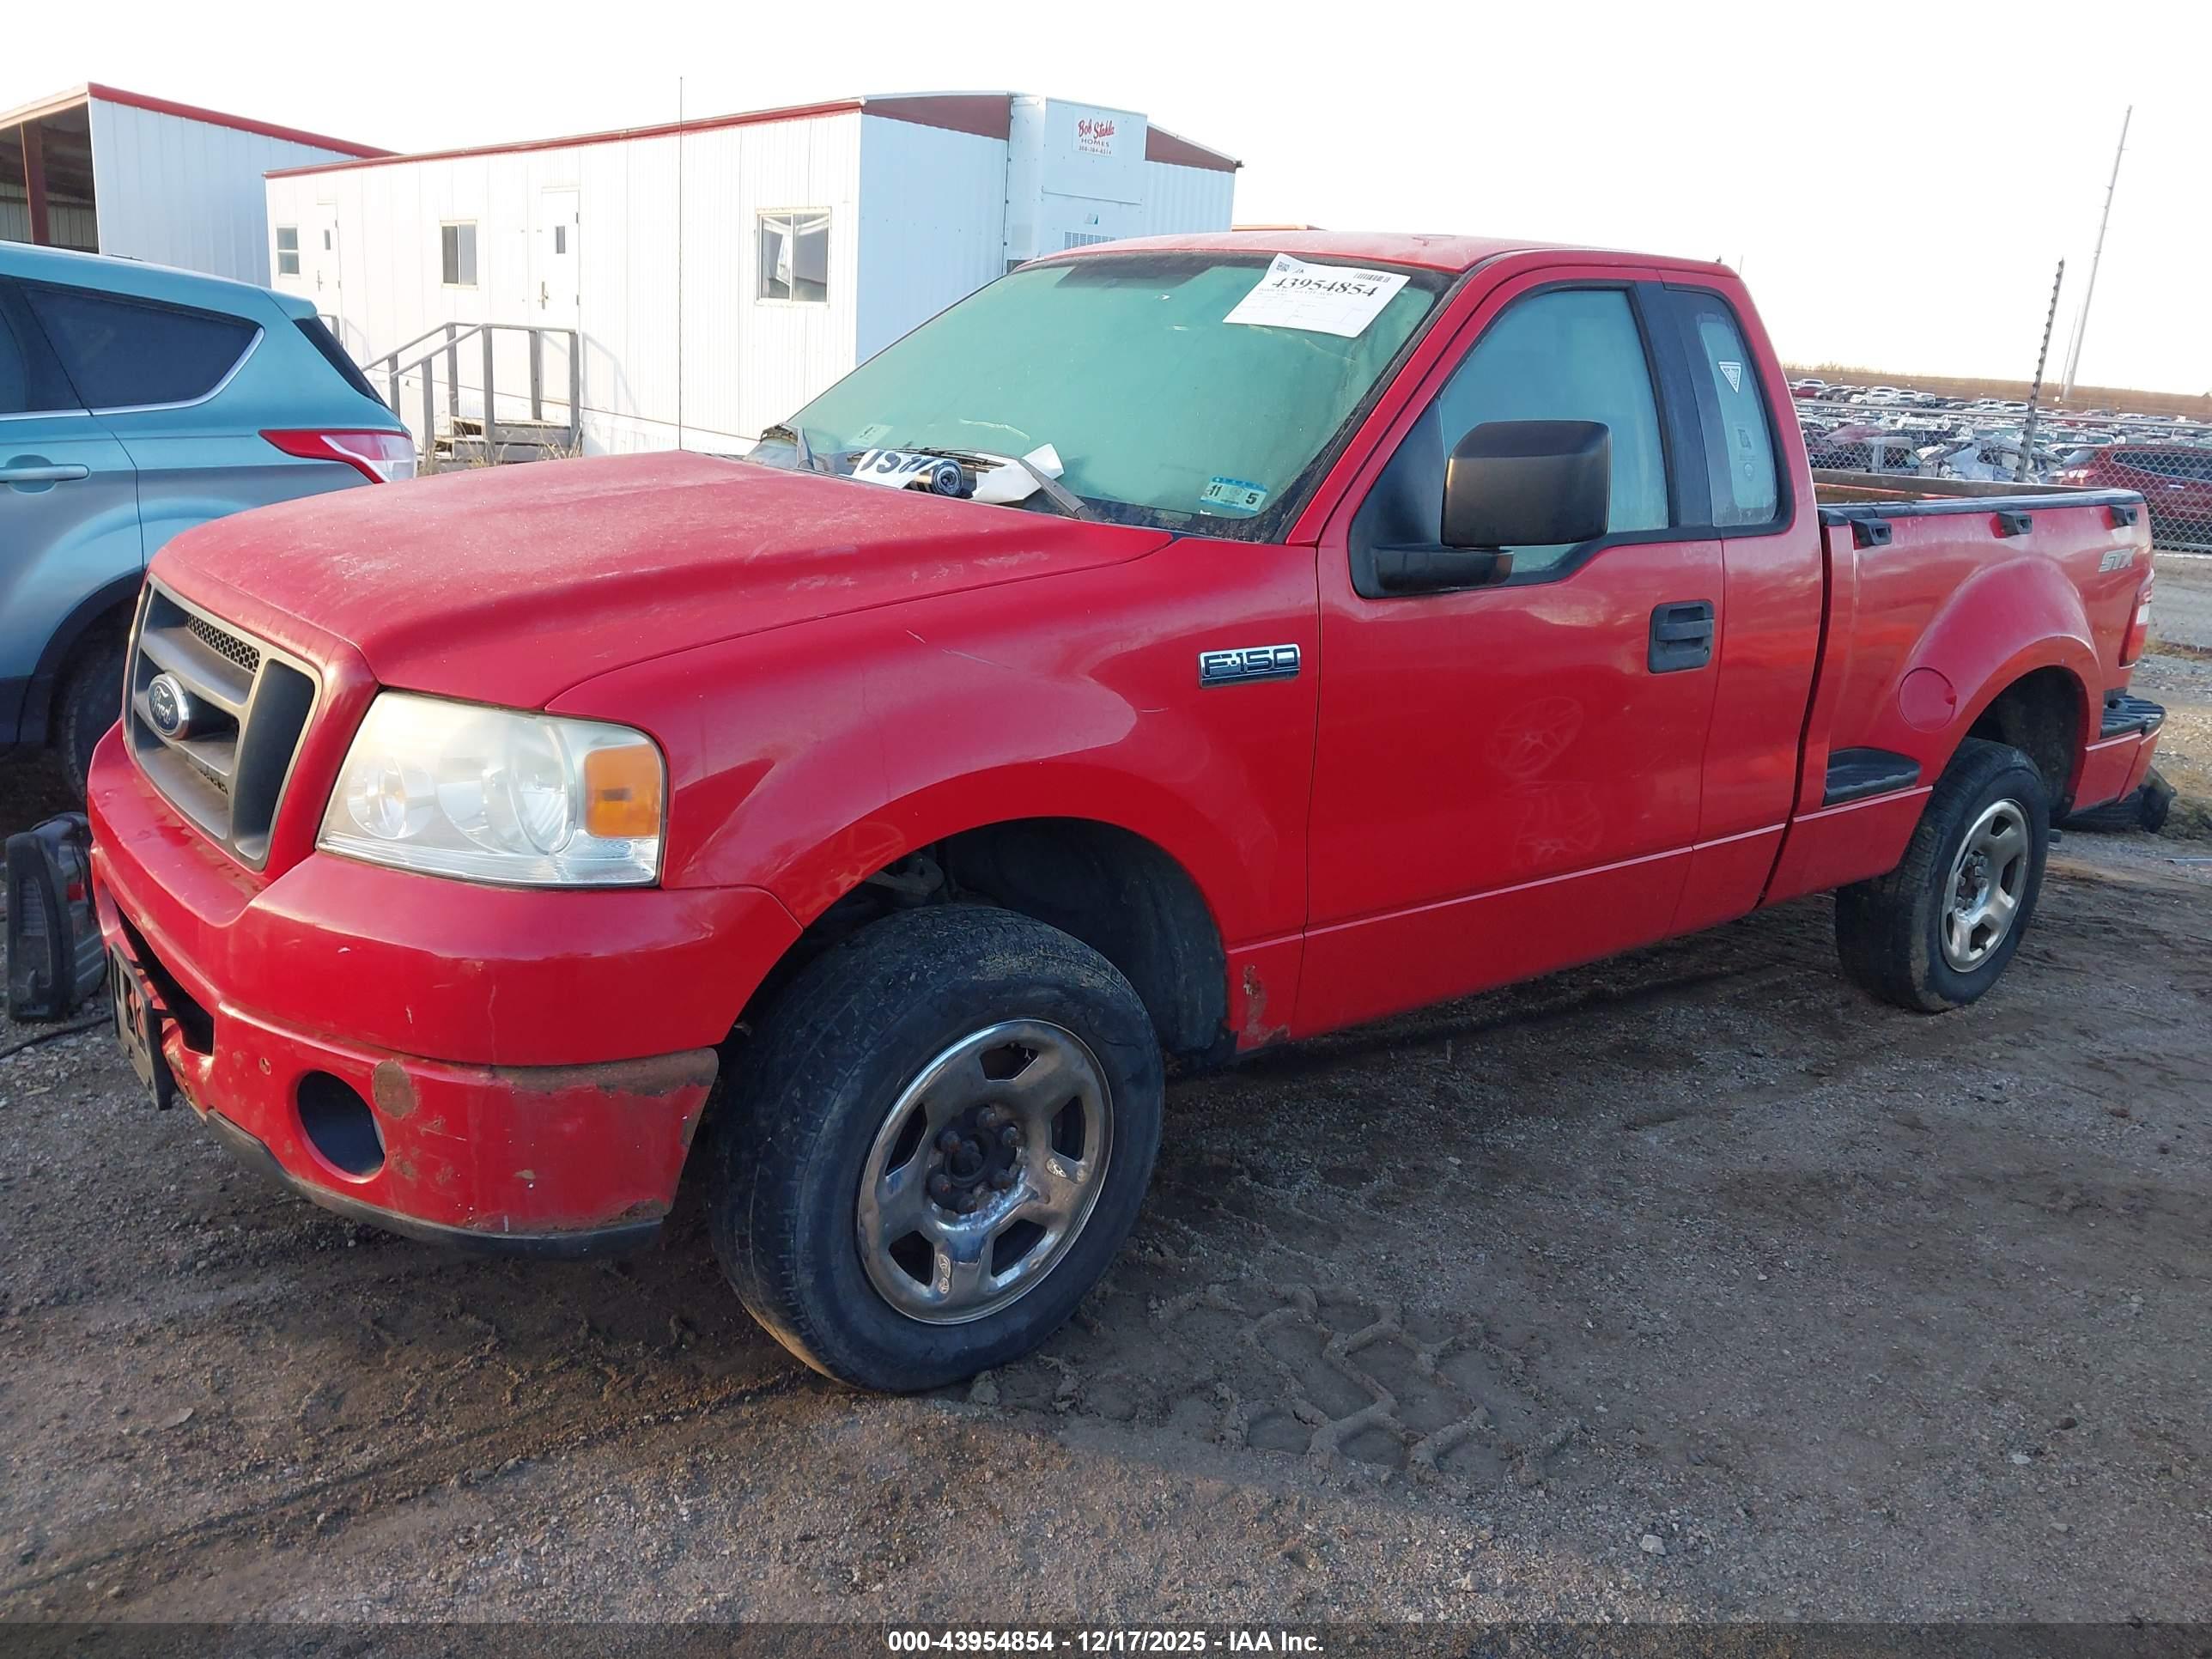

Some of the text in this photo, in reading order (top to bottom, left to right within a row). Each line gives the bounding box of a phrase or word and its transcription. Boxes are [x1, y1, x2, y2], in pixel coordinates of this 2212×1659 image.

[1078, 118, 1092, 137] Bob
[1081, 137, 1109, 148] HOMES
[1272, 277, 1378, 297] 43954854
[1245, 492, 1260, 505] 5
[2099, 548, 2137, 573] STX
[1203, 647, 1299, 677] F-150
[153, 685, 173, 725] Ford
